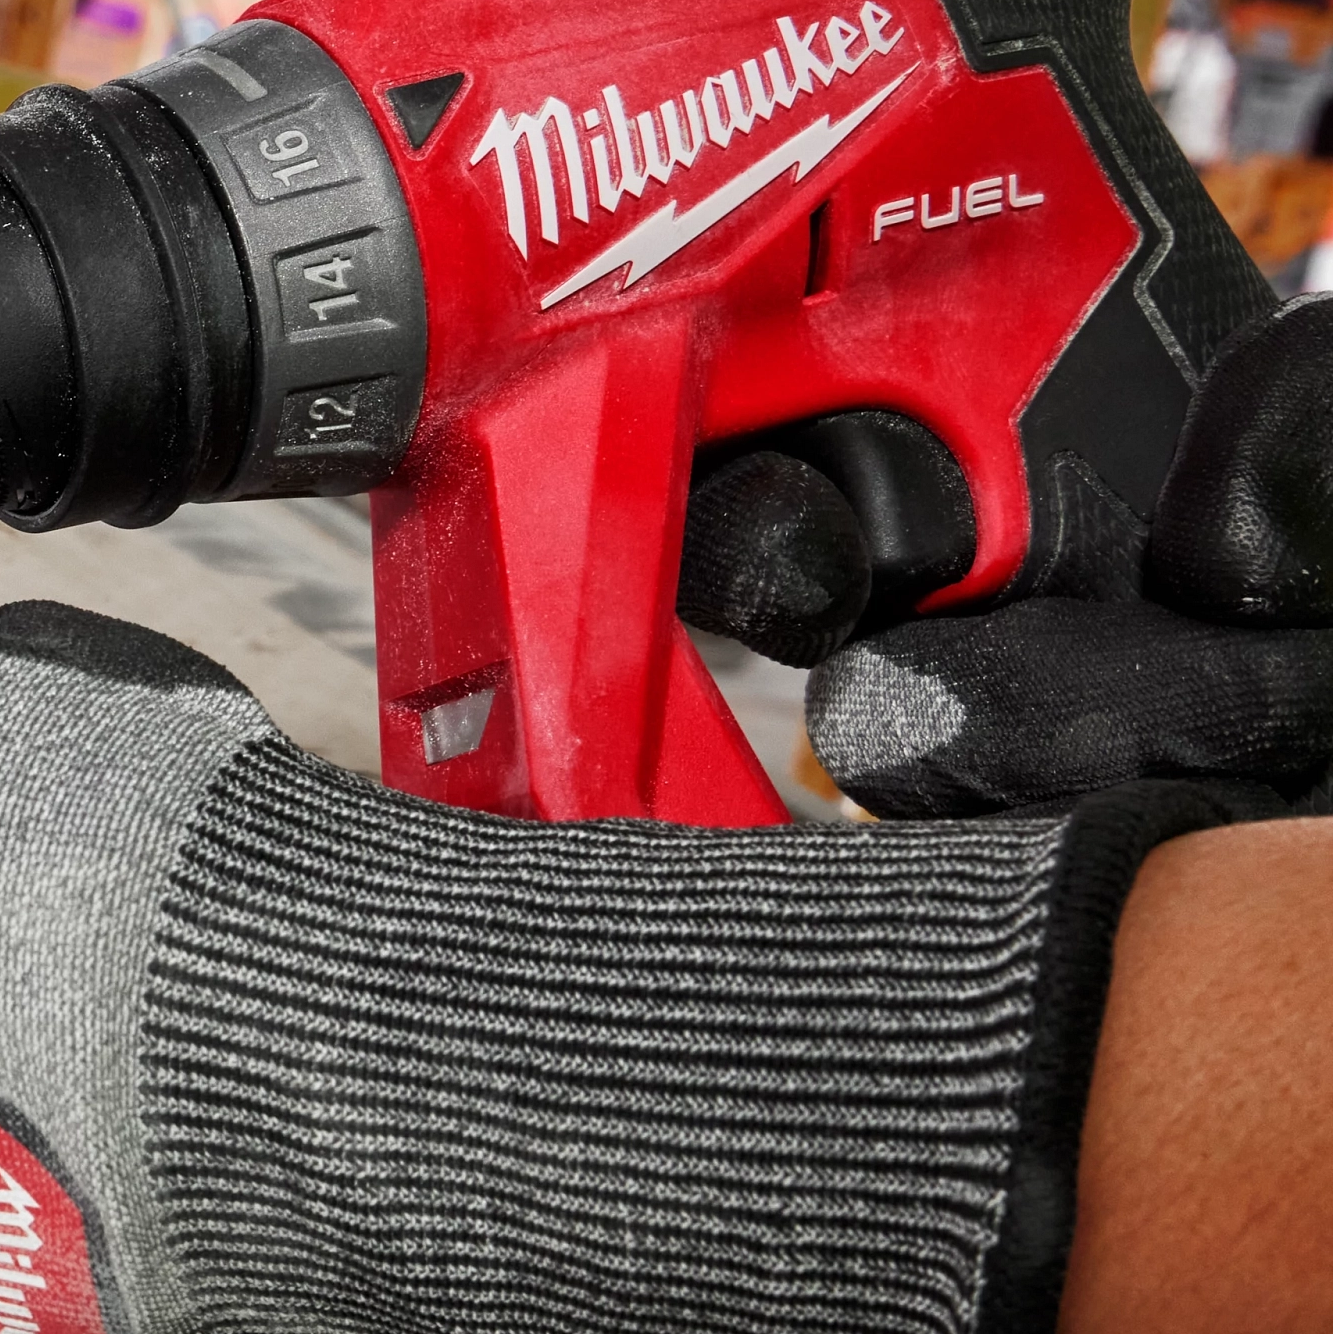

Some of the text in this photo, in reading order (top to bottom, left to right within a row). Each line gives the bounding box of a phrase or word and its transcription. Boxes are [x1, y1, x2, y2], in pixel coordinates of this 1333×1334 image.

[267, 126, 323, 187] 16
[470, 0, 906, 261] Milwaukee
[872, 173, 1044, 242] FUEL
[300, 252, 362, 322] 14
[308, 392, 357, 442] 12
